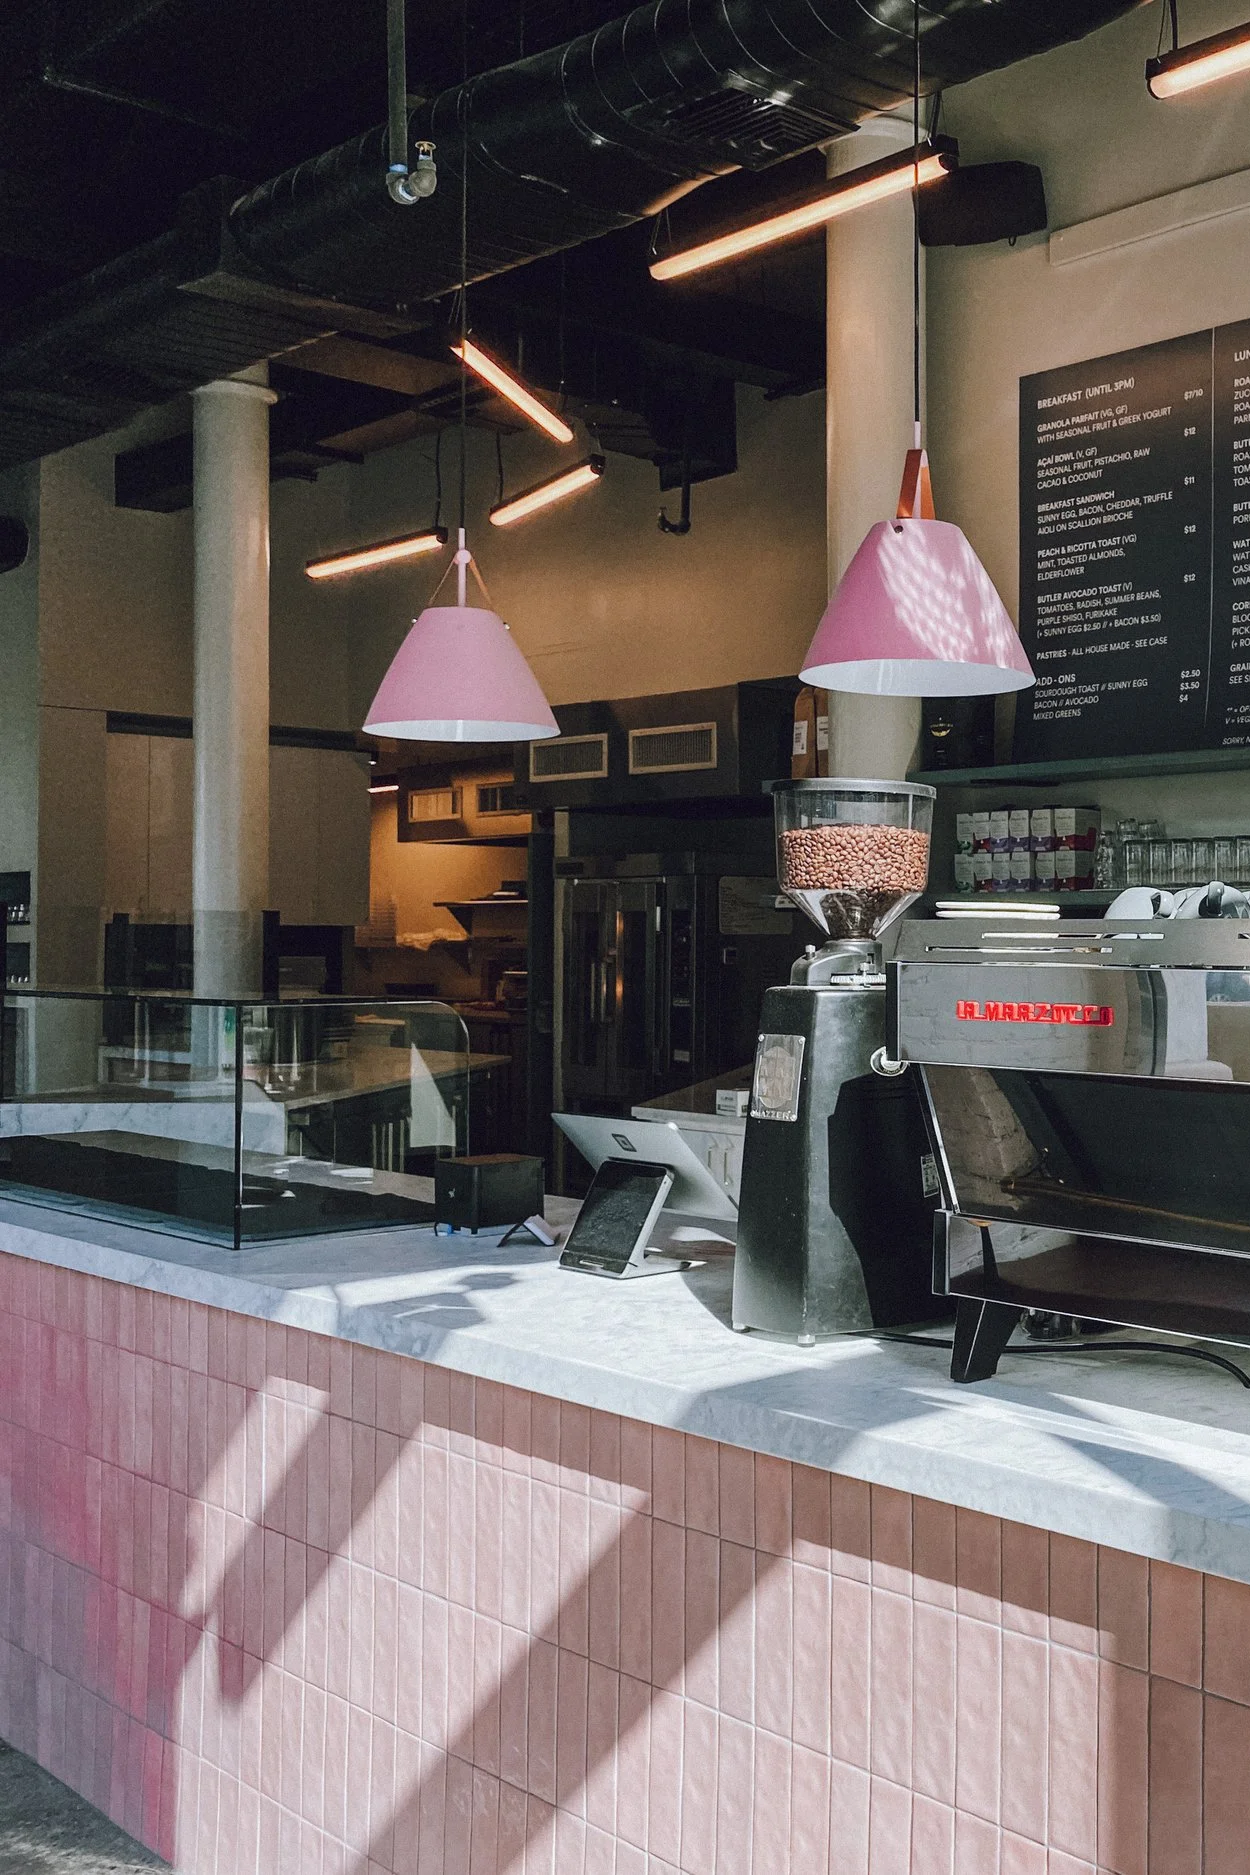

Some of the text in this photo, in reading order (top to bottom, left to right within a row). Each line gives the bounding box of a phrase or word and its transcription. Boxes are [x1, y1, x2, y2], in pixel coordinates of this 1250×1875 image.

[1037, 390, 1082, 409] BREAKFAST
[1184, 388, 1203, 400] $7/10
[1037, 418, 1070, 432] GRANOLA
[1071, 410, 1099, 425] PARFAIT
[1183, 426, 1195, 437] $12
[1054, 451, 1074, 463] BOWL
[1184, 476, 1194, 485] $11
[1037, 490, 1114, 512] BREAKFAST SANDWICH
[1037, 512, 1060, 524] SUNNY
[1142, 490, 1172, 504] TRUFFLE
[1184, 524, 1196, 534] $12
[1037, 566, 1084, 581] ELDERFLOWER
[1183, 573, 1195, 583] $12
[1037, 615, 1061, 626] PURPLE
[1085, 607, 1117, 619] FURIKAKE
[1180, 668, 1200, 679] $2.50
[1228, 674, 1242, 684] SEE
[1179, 680, 1199, 691] $3.50
[1178, 693, 1188, 702] $4
[1033, 708, 1081, 720] MIXED GREENS
